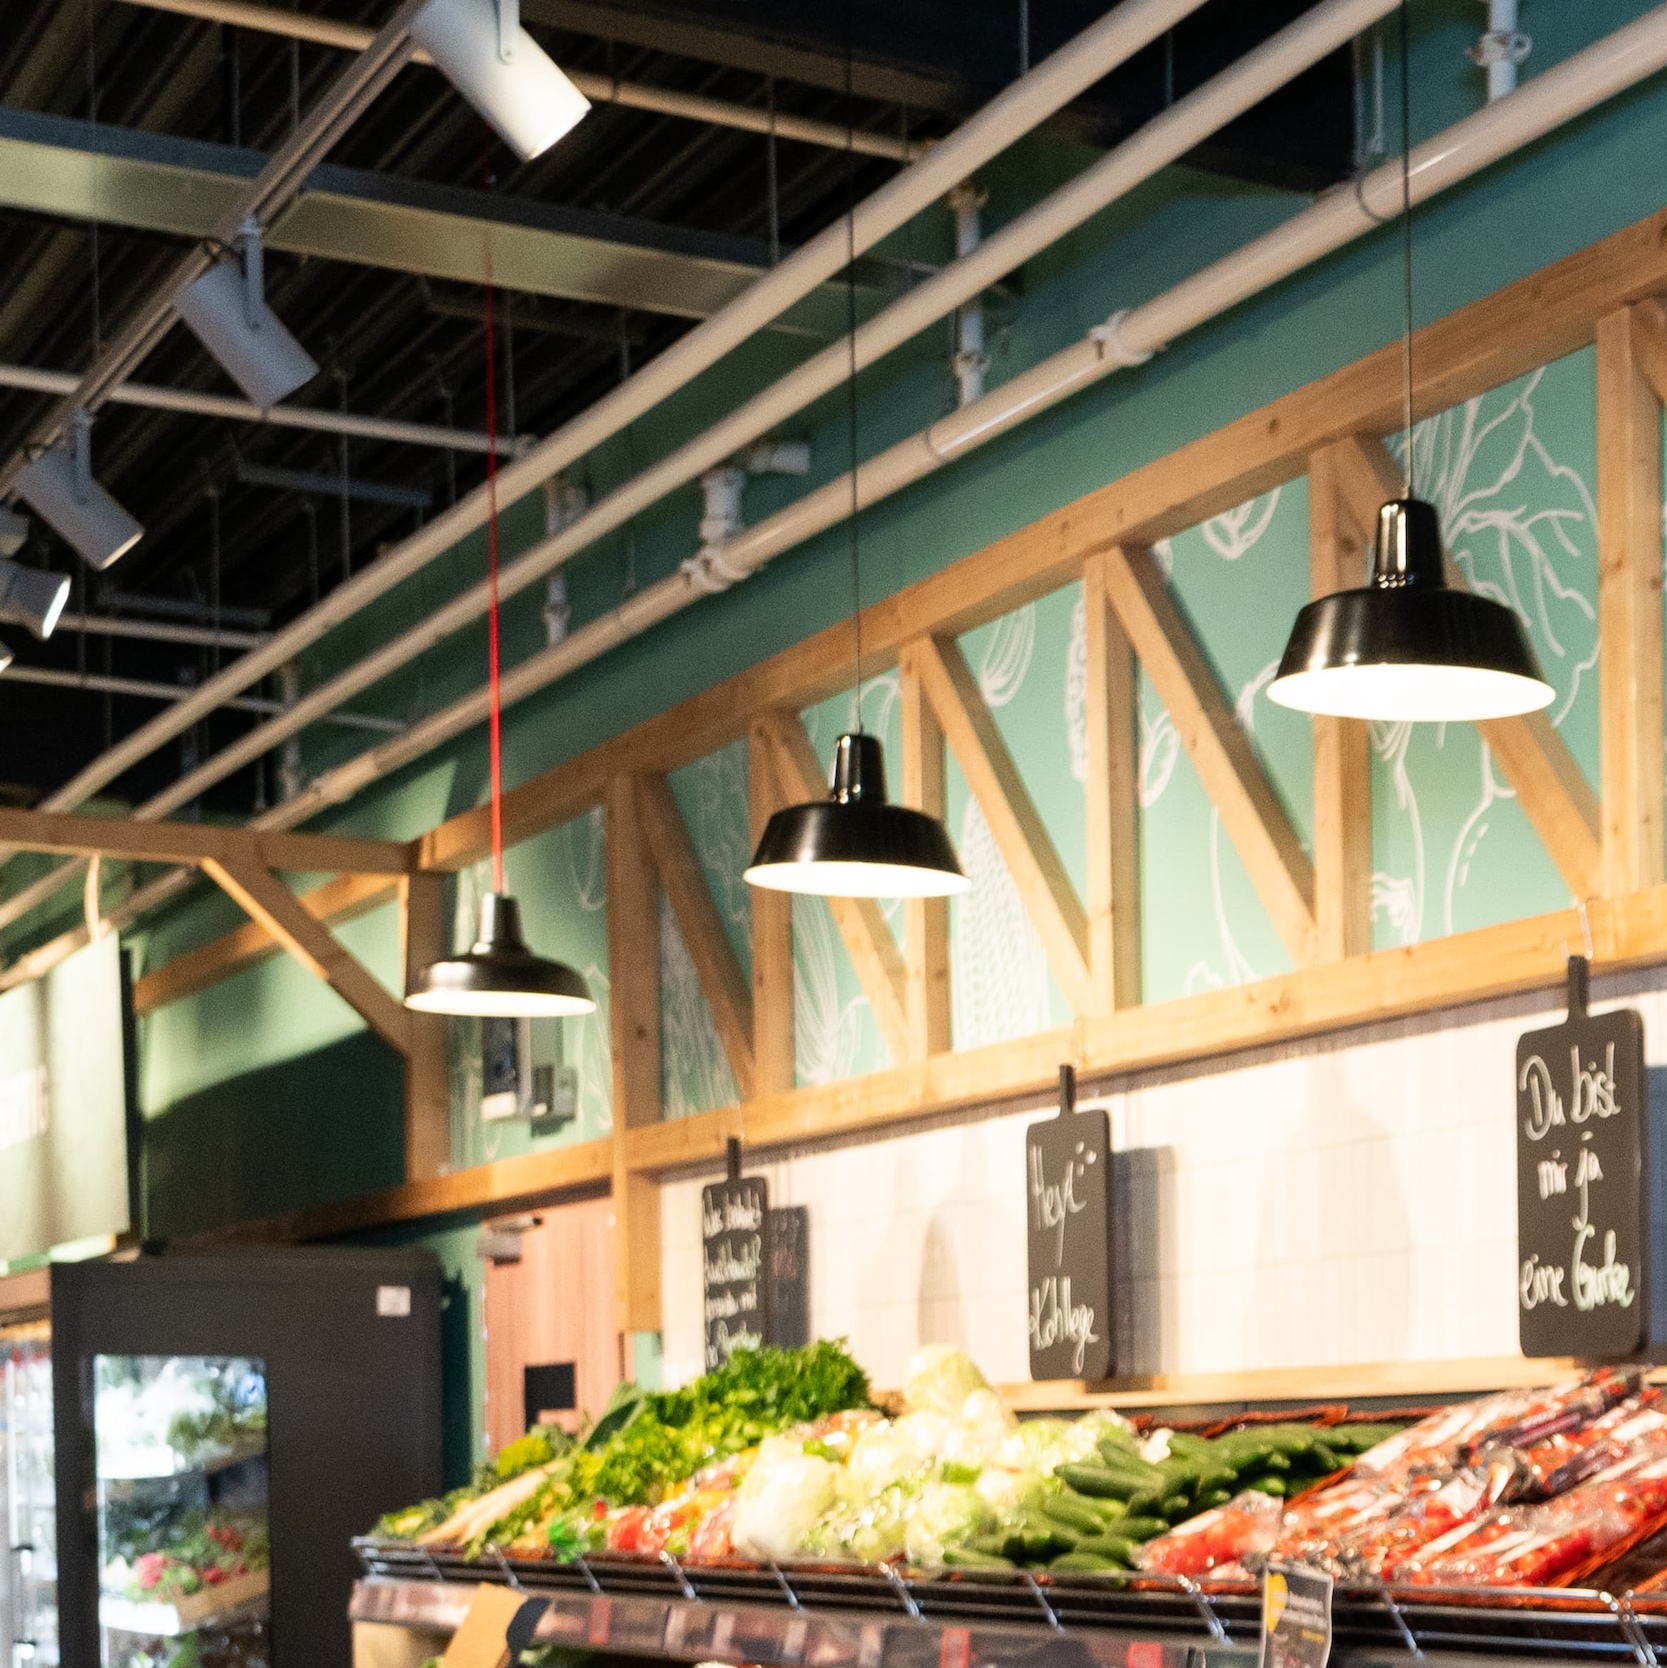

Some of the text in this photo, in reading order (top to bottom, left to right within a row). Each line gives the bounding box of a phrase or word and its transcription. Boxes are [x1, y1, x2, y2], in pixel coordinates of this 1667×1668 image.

[1519, 1041, 1622, 1141] Du bist
[1571, 1131, 1604, 1231] ja
[1519, 1253, 1569, 1310] eine
